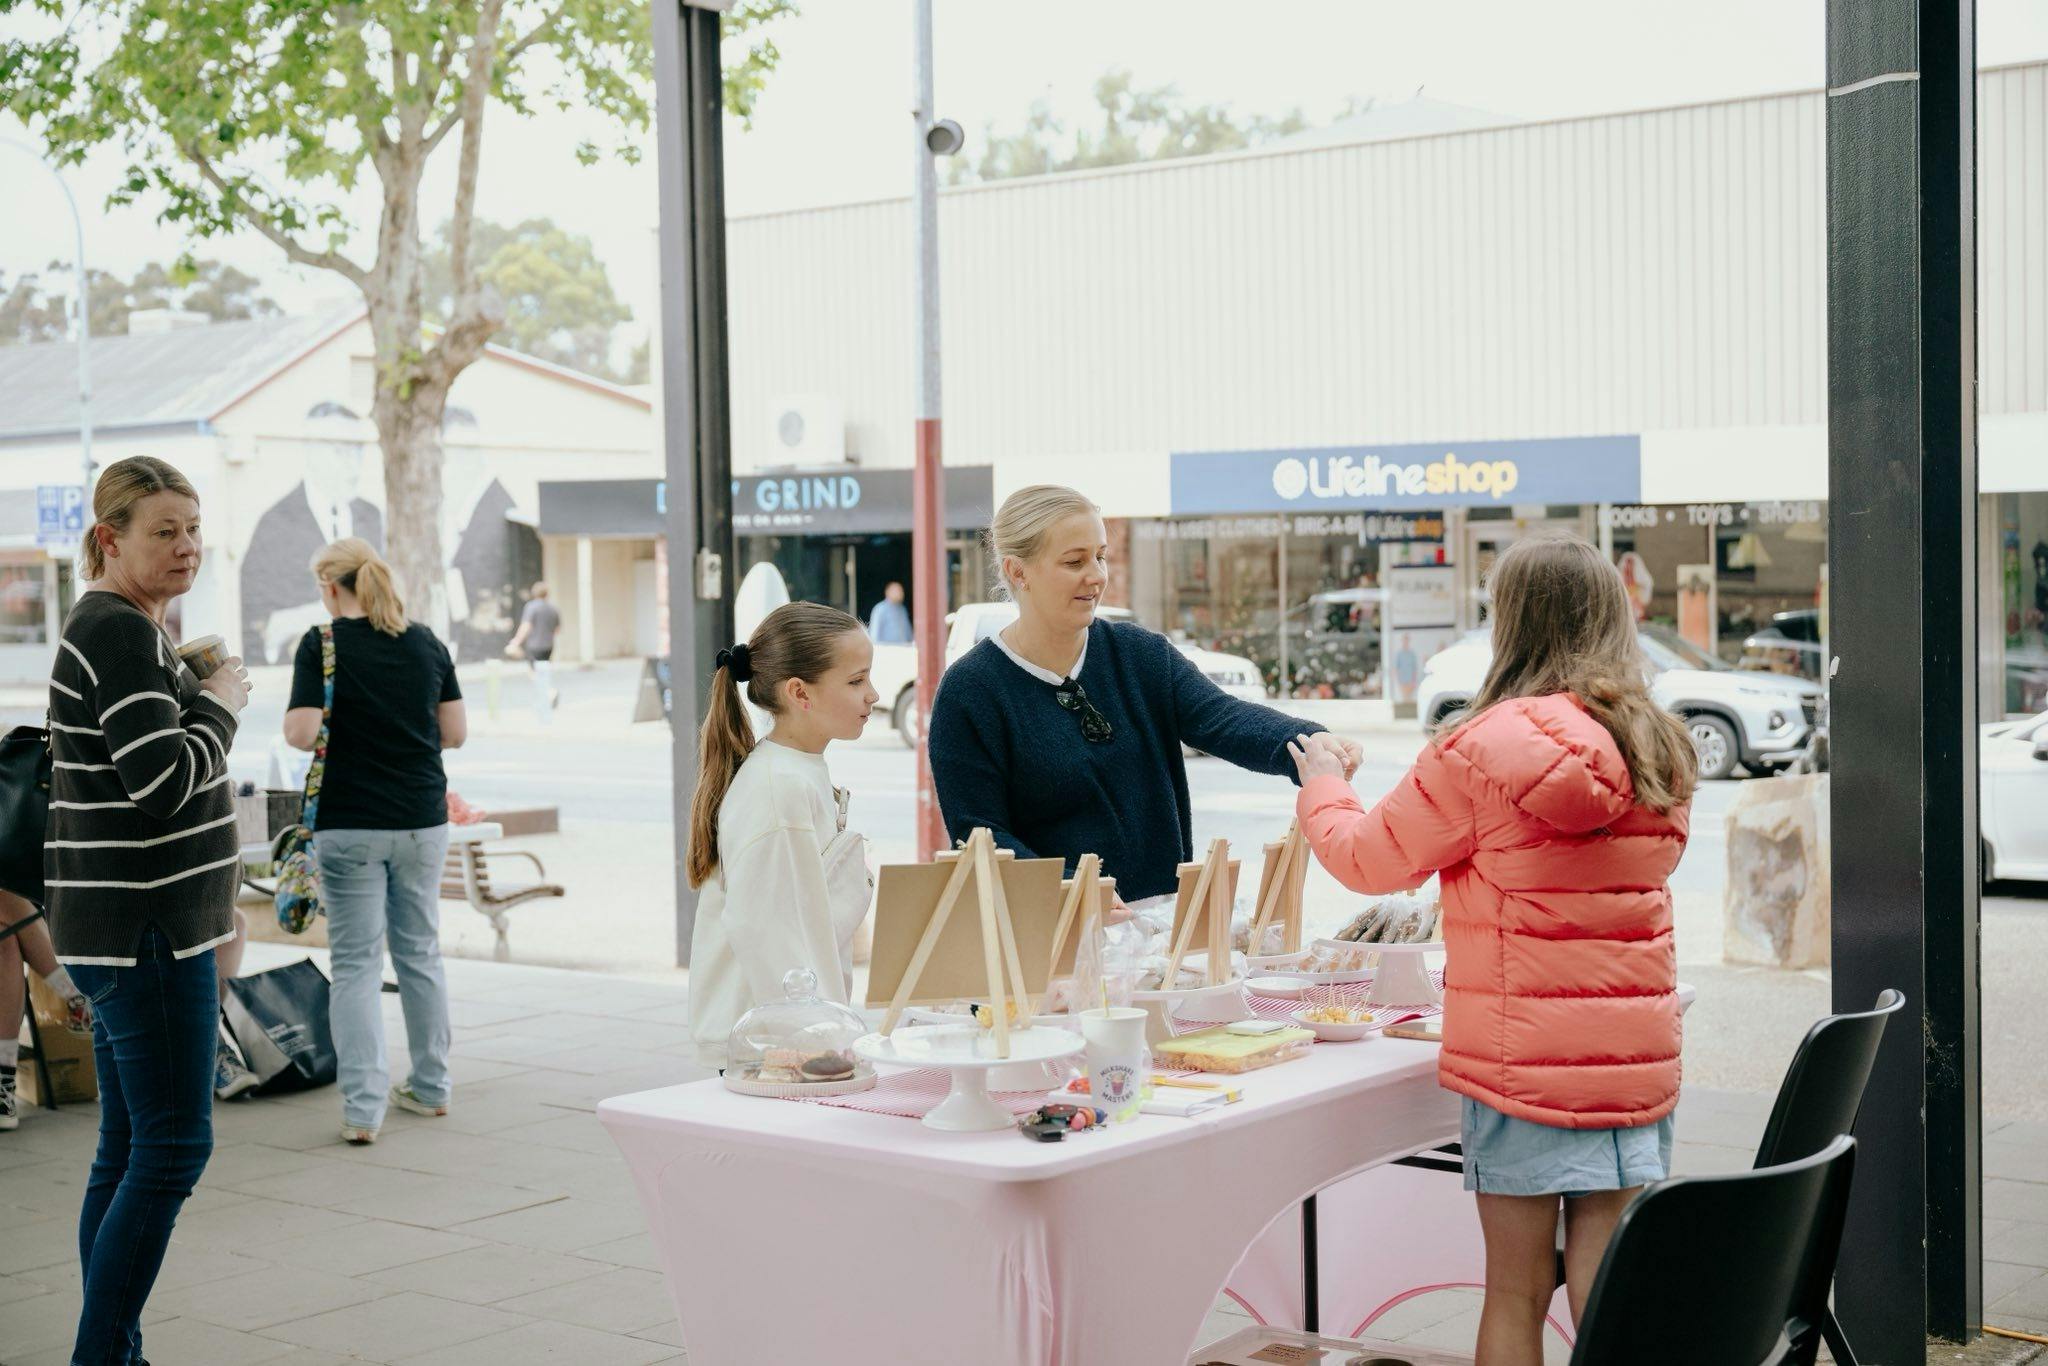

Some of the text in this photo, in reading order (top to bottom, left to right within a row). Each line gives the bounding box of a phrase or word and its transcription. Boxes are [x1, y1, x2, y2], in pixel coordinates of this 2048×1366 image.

[756, 477, 861, 512] GRIND
[1598, 501, 1820, 528] OOKS TOYS SHOES
[1102, 1090, 1134, 1103] MASTERS
